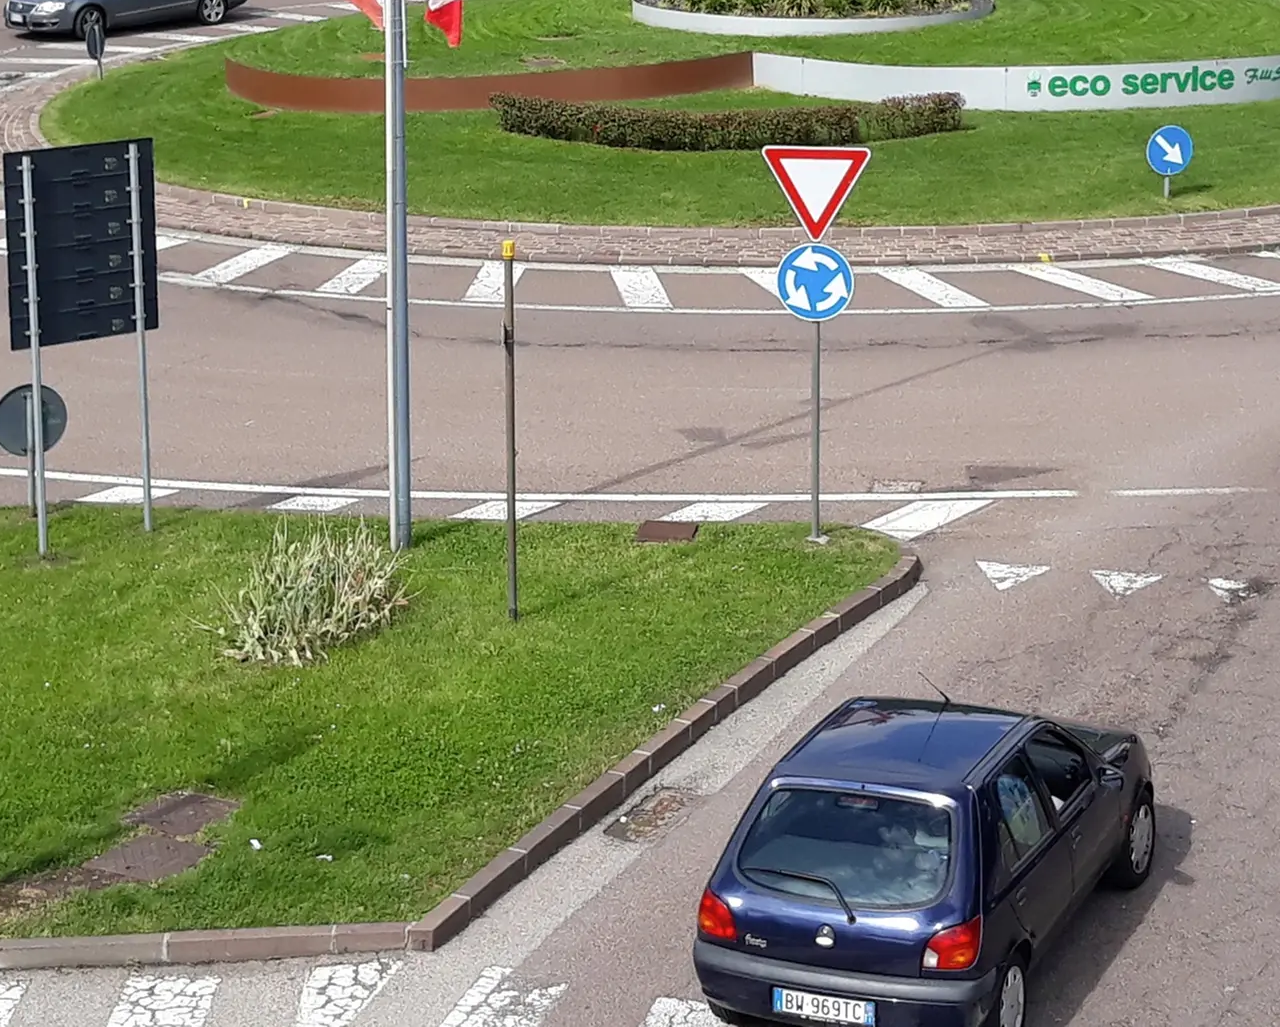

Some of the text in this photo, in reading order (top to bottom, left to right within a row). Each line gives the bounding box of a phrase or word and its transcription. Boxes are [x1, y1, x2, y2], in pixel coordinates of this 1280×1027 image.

[1048, 75, 1111, 97] eco
[1121, 65, 1235, 96] service
[785, 992, 804, 1012] BW
[810, 996, 862, 1021] 969TC
